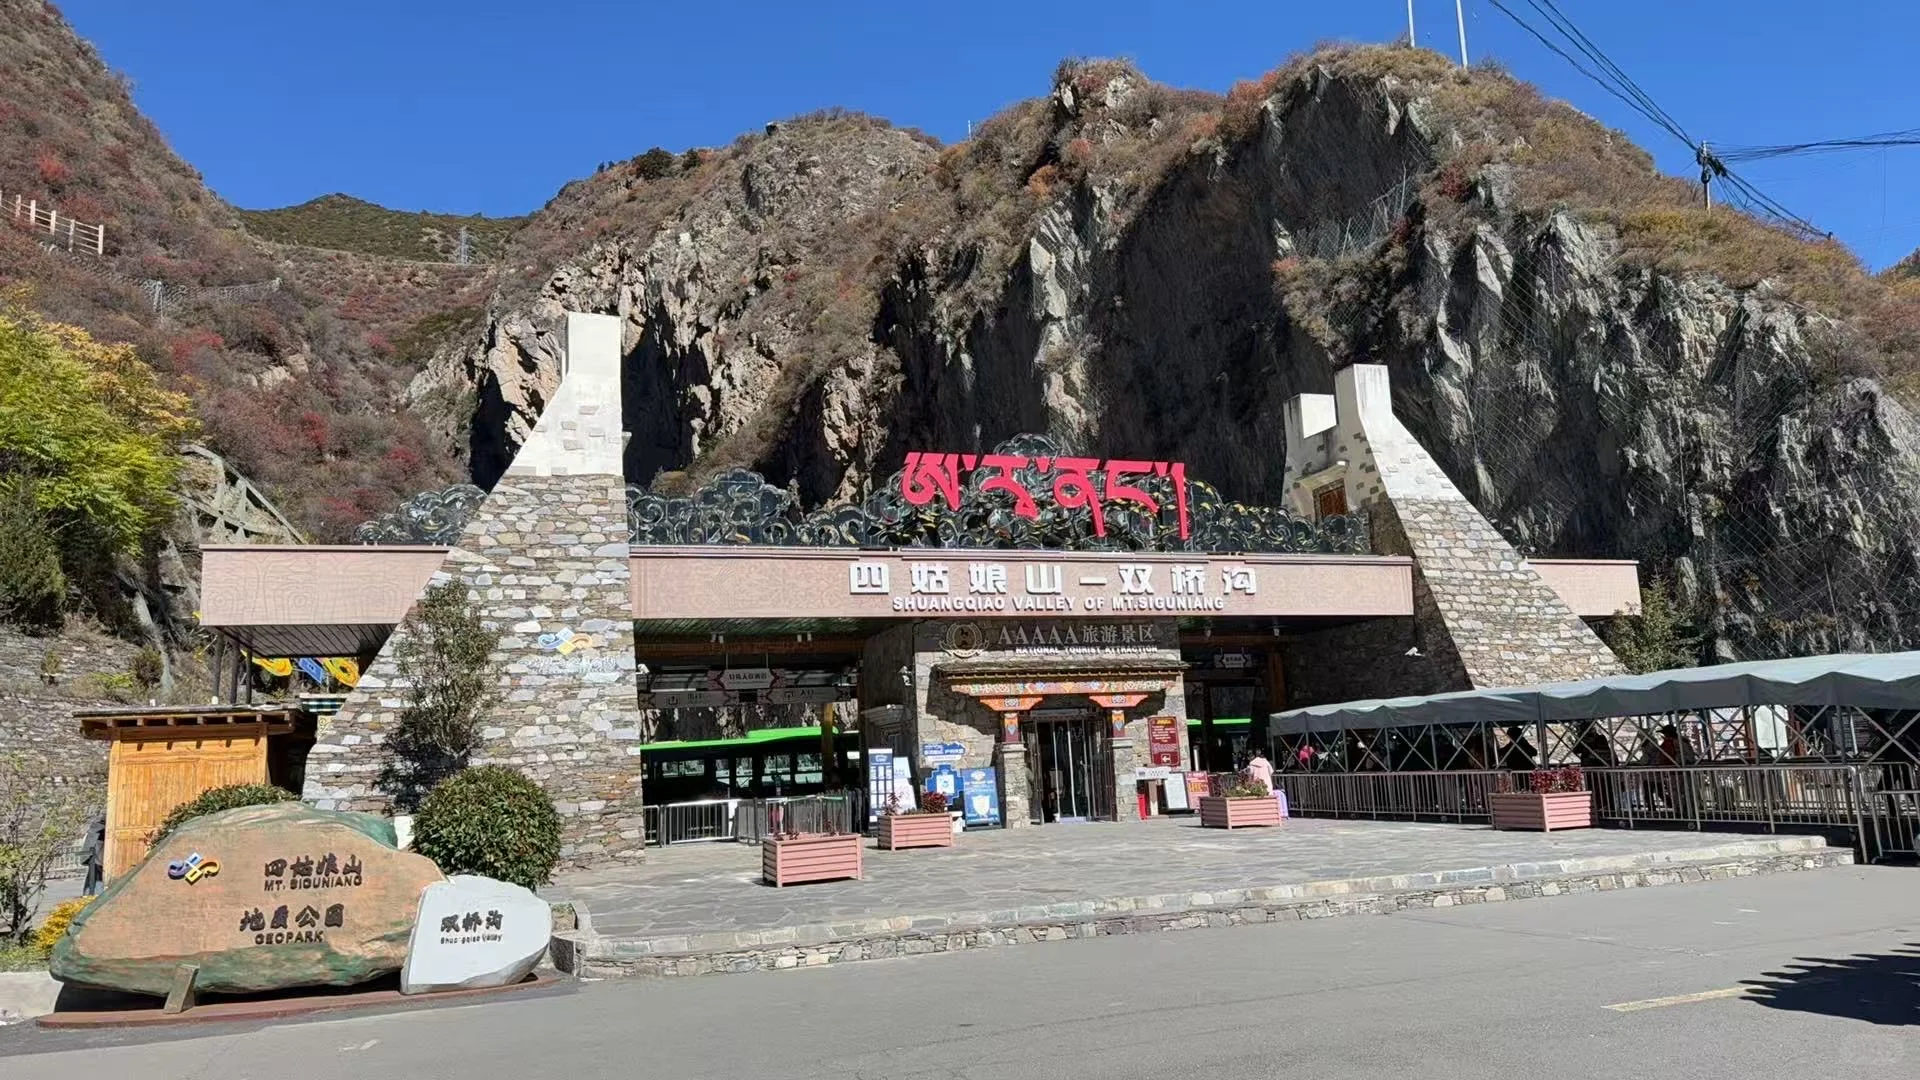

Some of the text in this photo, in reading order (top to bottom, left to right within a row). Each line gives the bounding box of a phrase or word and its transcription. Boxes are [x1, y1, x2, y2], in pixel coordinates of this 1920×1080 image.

[893, 596, 1006, 612] SHUANGQIAO
[1013, 596, 1075, 612] VALLEY
[1084, 597, 1104, 611] OF
[1015, 645, 1158, 655] NATIONAL TOURIST ATTRACTION
[264, 852, 362, 878] 四姑娘山
[290, 876, 362, 890] SIGUNIANG
[239, 903, 345, 932] 地质公园
[440, 910, 504, 932] 双桥沟
[254, 931, 324, 945] GEOPARK
